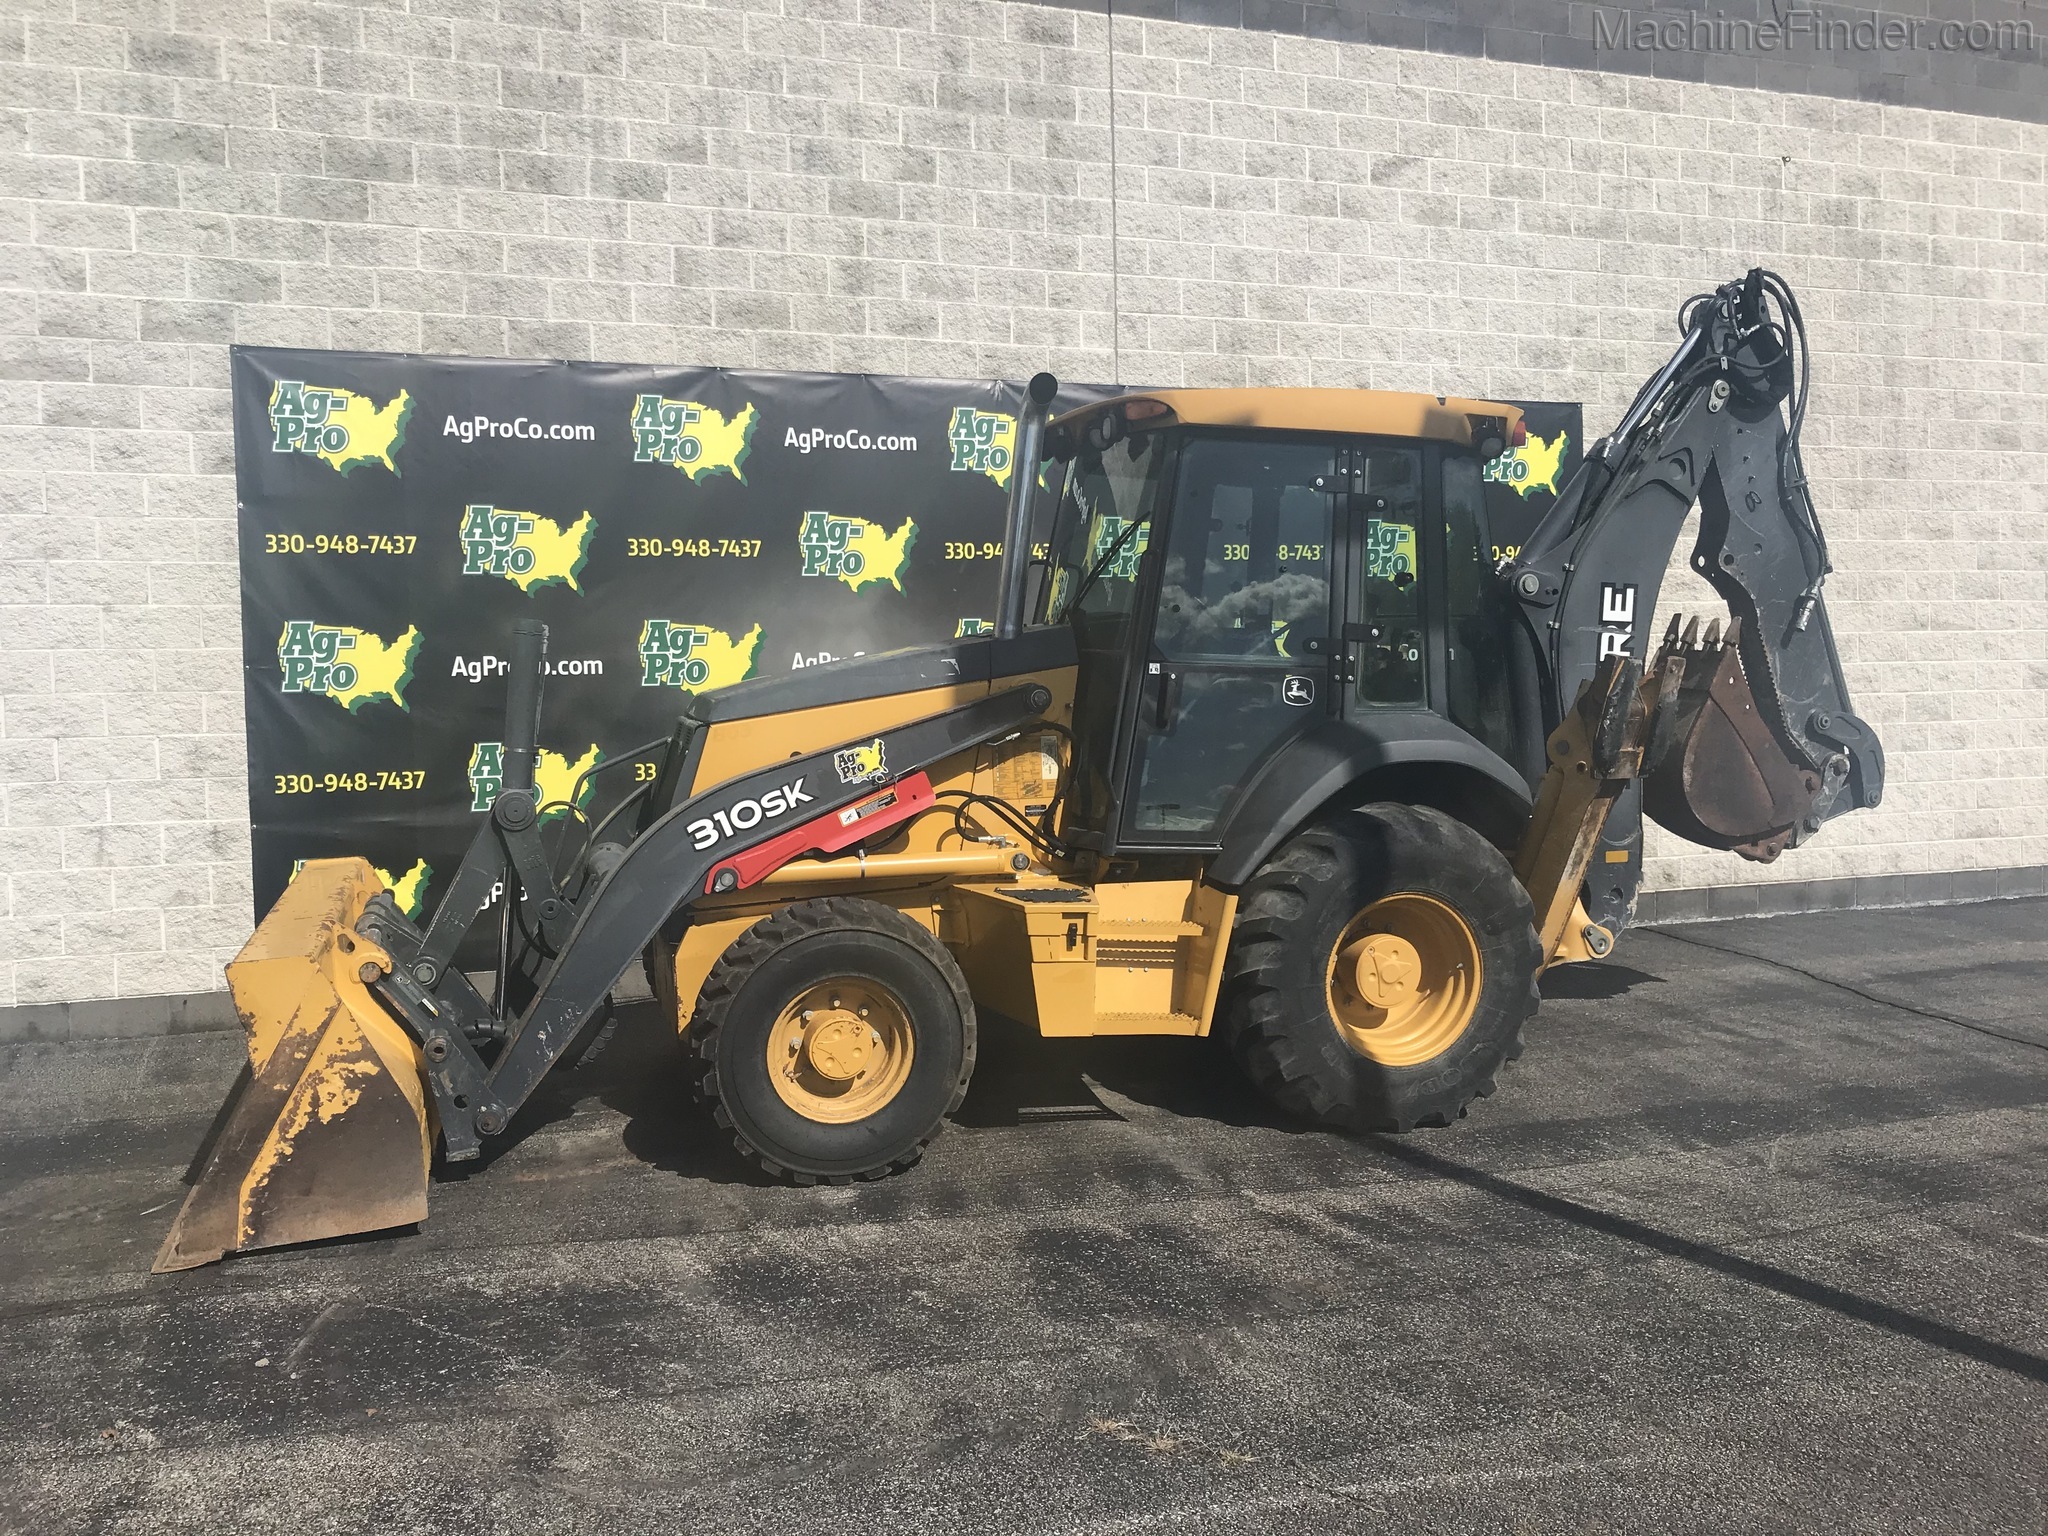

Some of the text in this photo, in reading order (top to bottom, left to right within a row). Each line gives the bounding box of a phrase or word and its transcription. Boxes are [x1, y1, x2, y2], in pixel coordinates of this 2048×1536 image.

[274, 381, 347, 423] Ag-
[635, 394, 700, 434] Ag-
[273, 416, 349, 452] Pro
[443, 415, 595, 443] AgProCo.com
[784, 427, 917, 453] AgProCo.com
[952, 407, 1009, 442] Ag-
[634, 427, 702, 462] Pro
[951, 438, 1010, 471] Pro
[464, 505, 533, 547] Ag-
[802, 511, 864, 548] Ag-
[265, 534, 417, 556] 330-948-7437
[462, 539, 535, 576] Pro
[627, 538, 761, 559] 330-948-7437
[801, 544, 865, 577] Pro
[284, 621, 354, 664] Ag-
[644, 620, 708, 660] Ag-
[282, 656, 357, 693] Pro
[642, 652, 710, 687] Pro
[275, 771, 426, 794] 330-948-7437
[840, 762, 865, 780] Pro
[686, 777, 814, 850] 310SK
